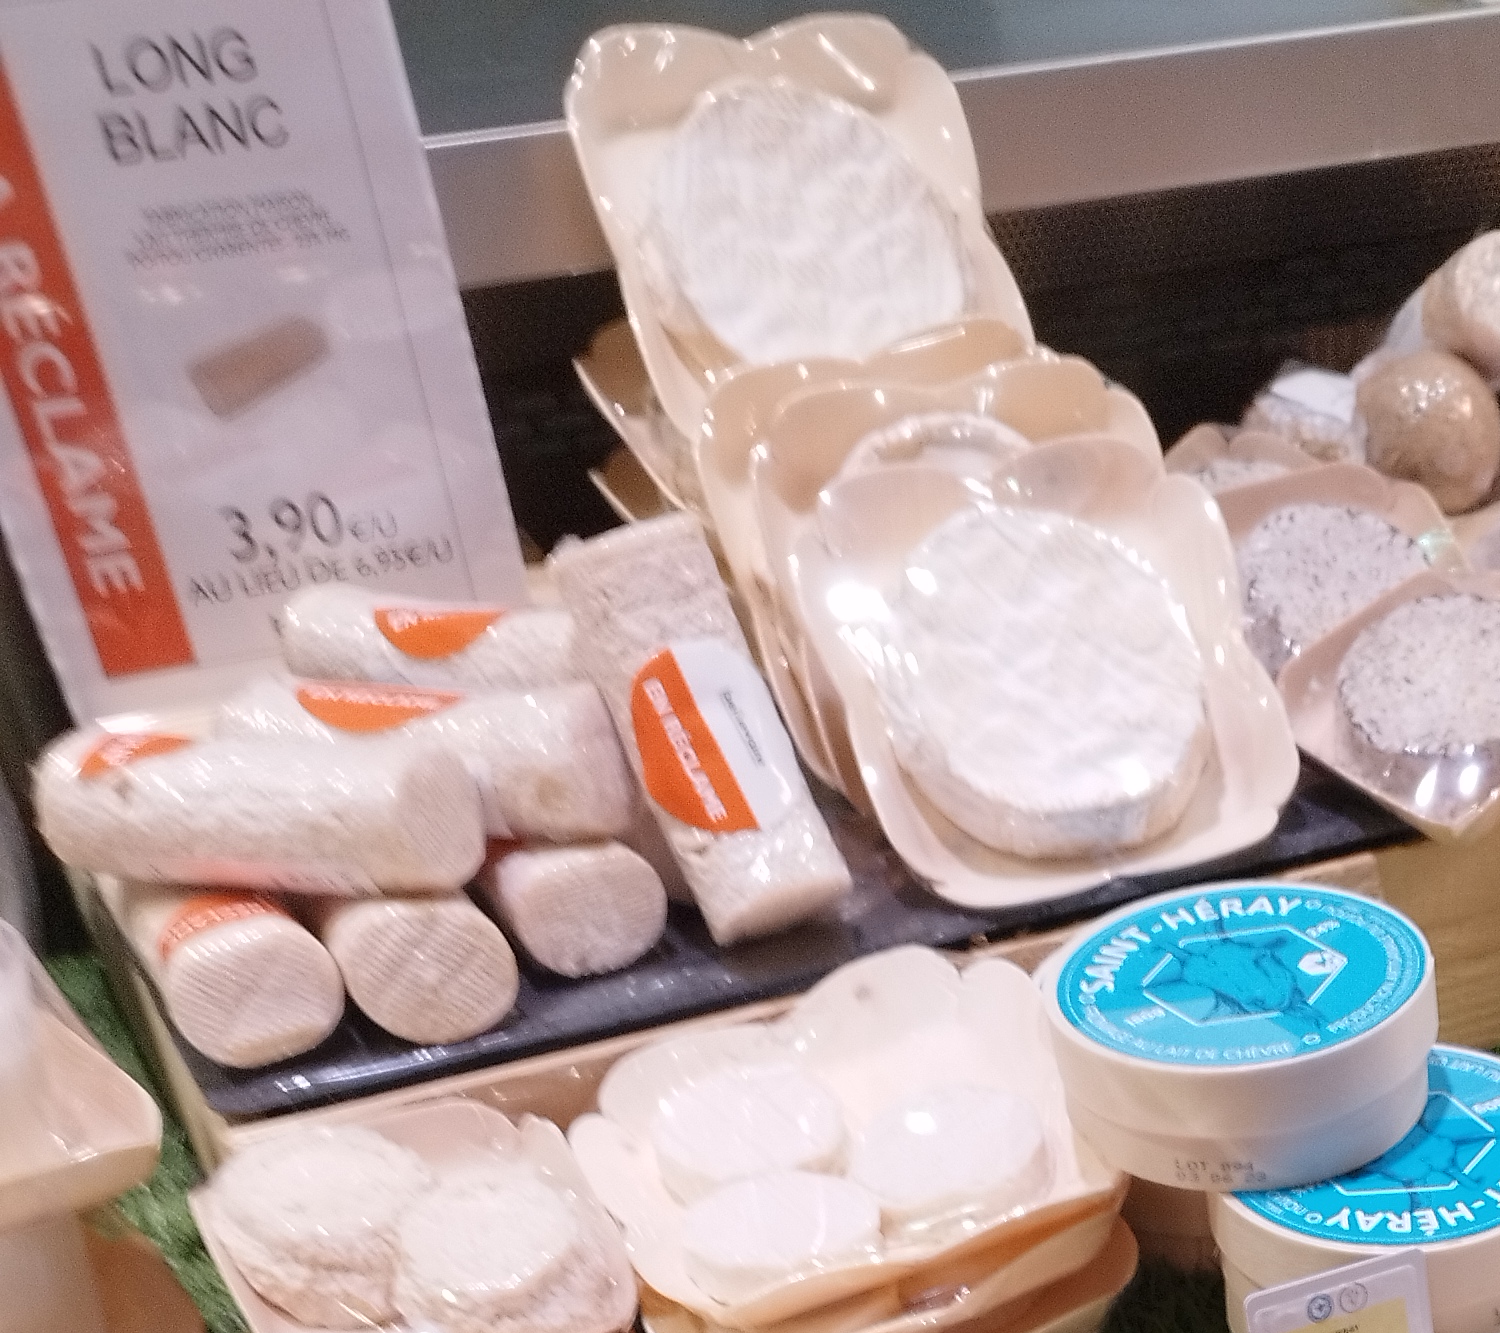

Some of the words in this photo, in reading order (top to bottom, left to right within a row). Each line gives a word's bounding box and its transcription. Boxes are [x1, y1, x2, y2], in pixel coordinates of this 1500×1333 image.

[87, 25, 258, 97] LONG
[97, 94, 289, 166] BLANC
[0, 238, 146, 598] RÉCLAME
[218, 490, 344, 564] 3,90
[188, 573, 233, 606] AU
[234, 560, 301, 600] LIEU
[303, 554, 350, 585] DE
[641, 676, 674, 716] EN
[1079, 895, 1302, 993] SAINT-HÉRAY
